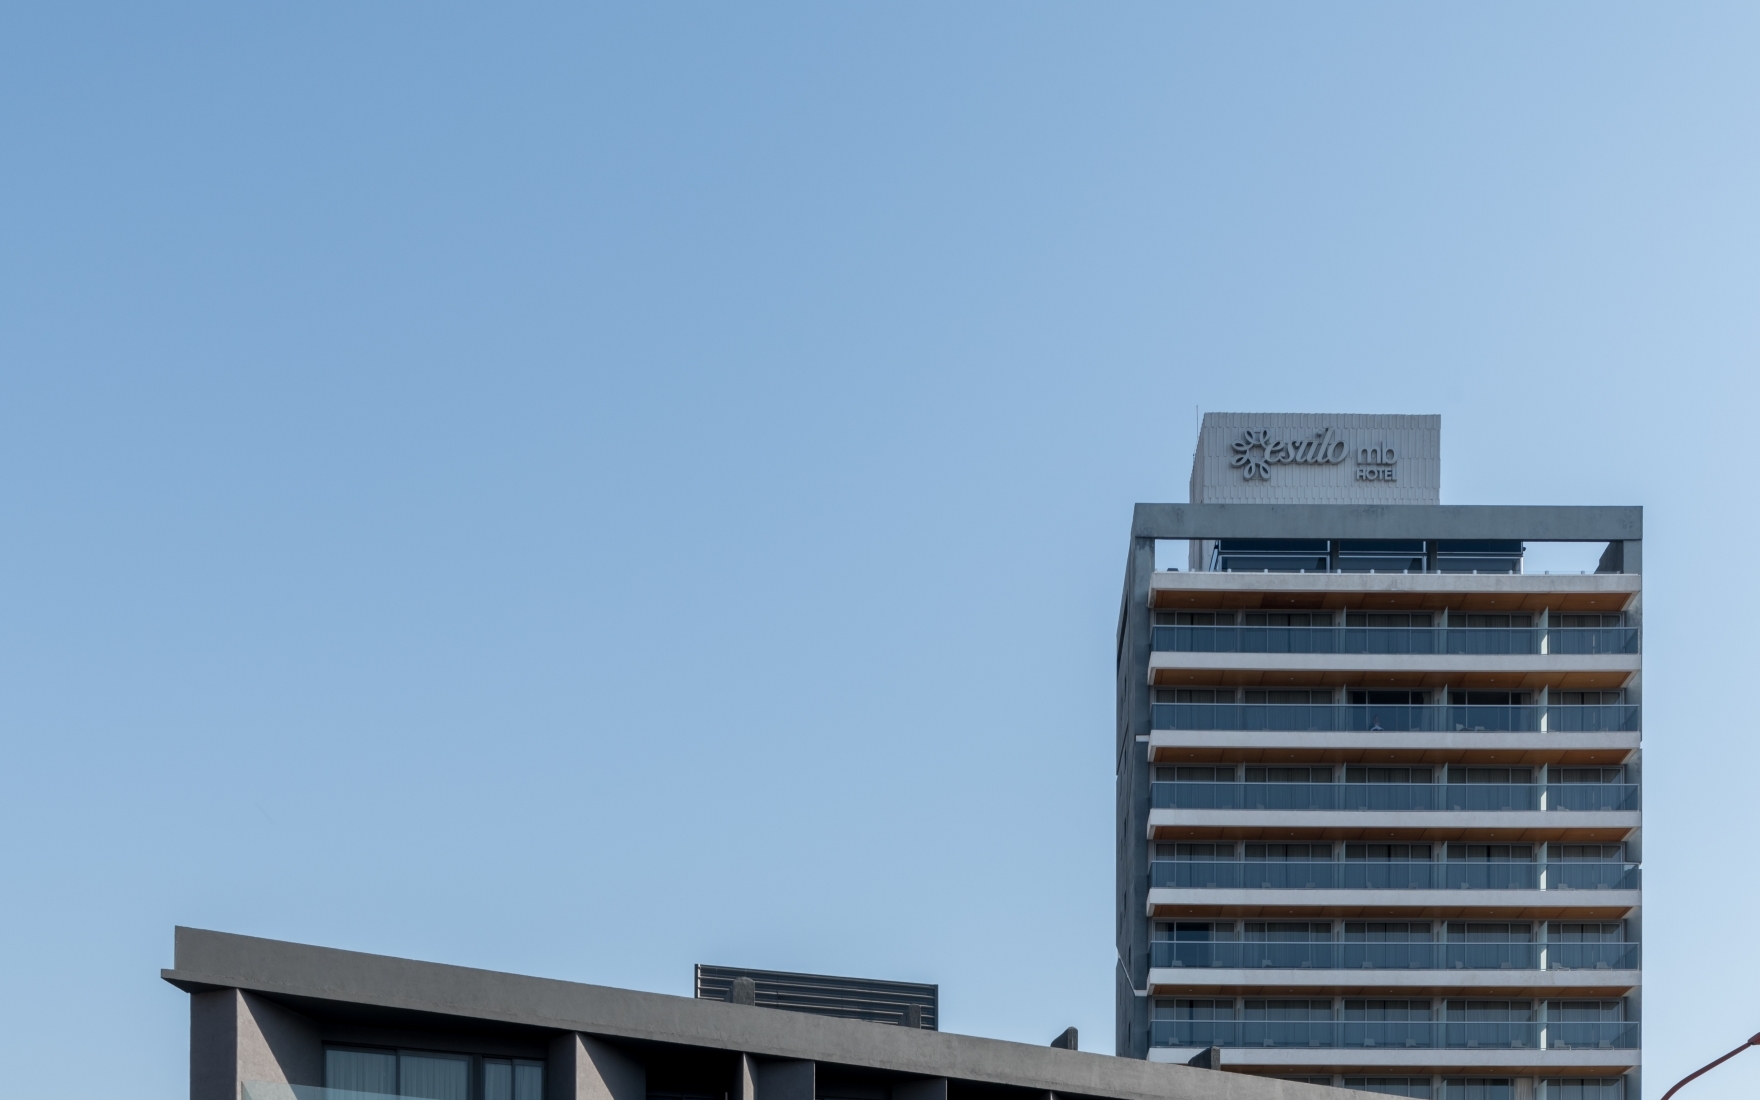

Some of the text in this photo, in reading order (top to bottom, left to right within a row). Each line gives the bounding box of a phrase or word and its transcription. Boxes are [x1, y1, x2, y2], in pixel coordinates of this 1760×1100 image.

[1263, 427, 1349, 464] estilo
[1357, 441, 1398, 464] mb
[1357, 467, 1397, 481] HOTEL
